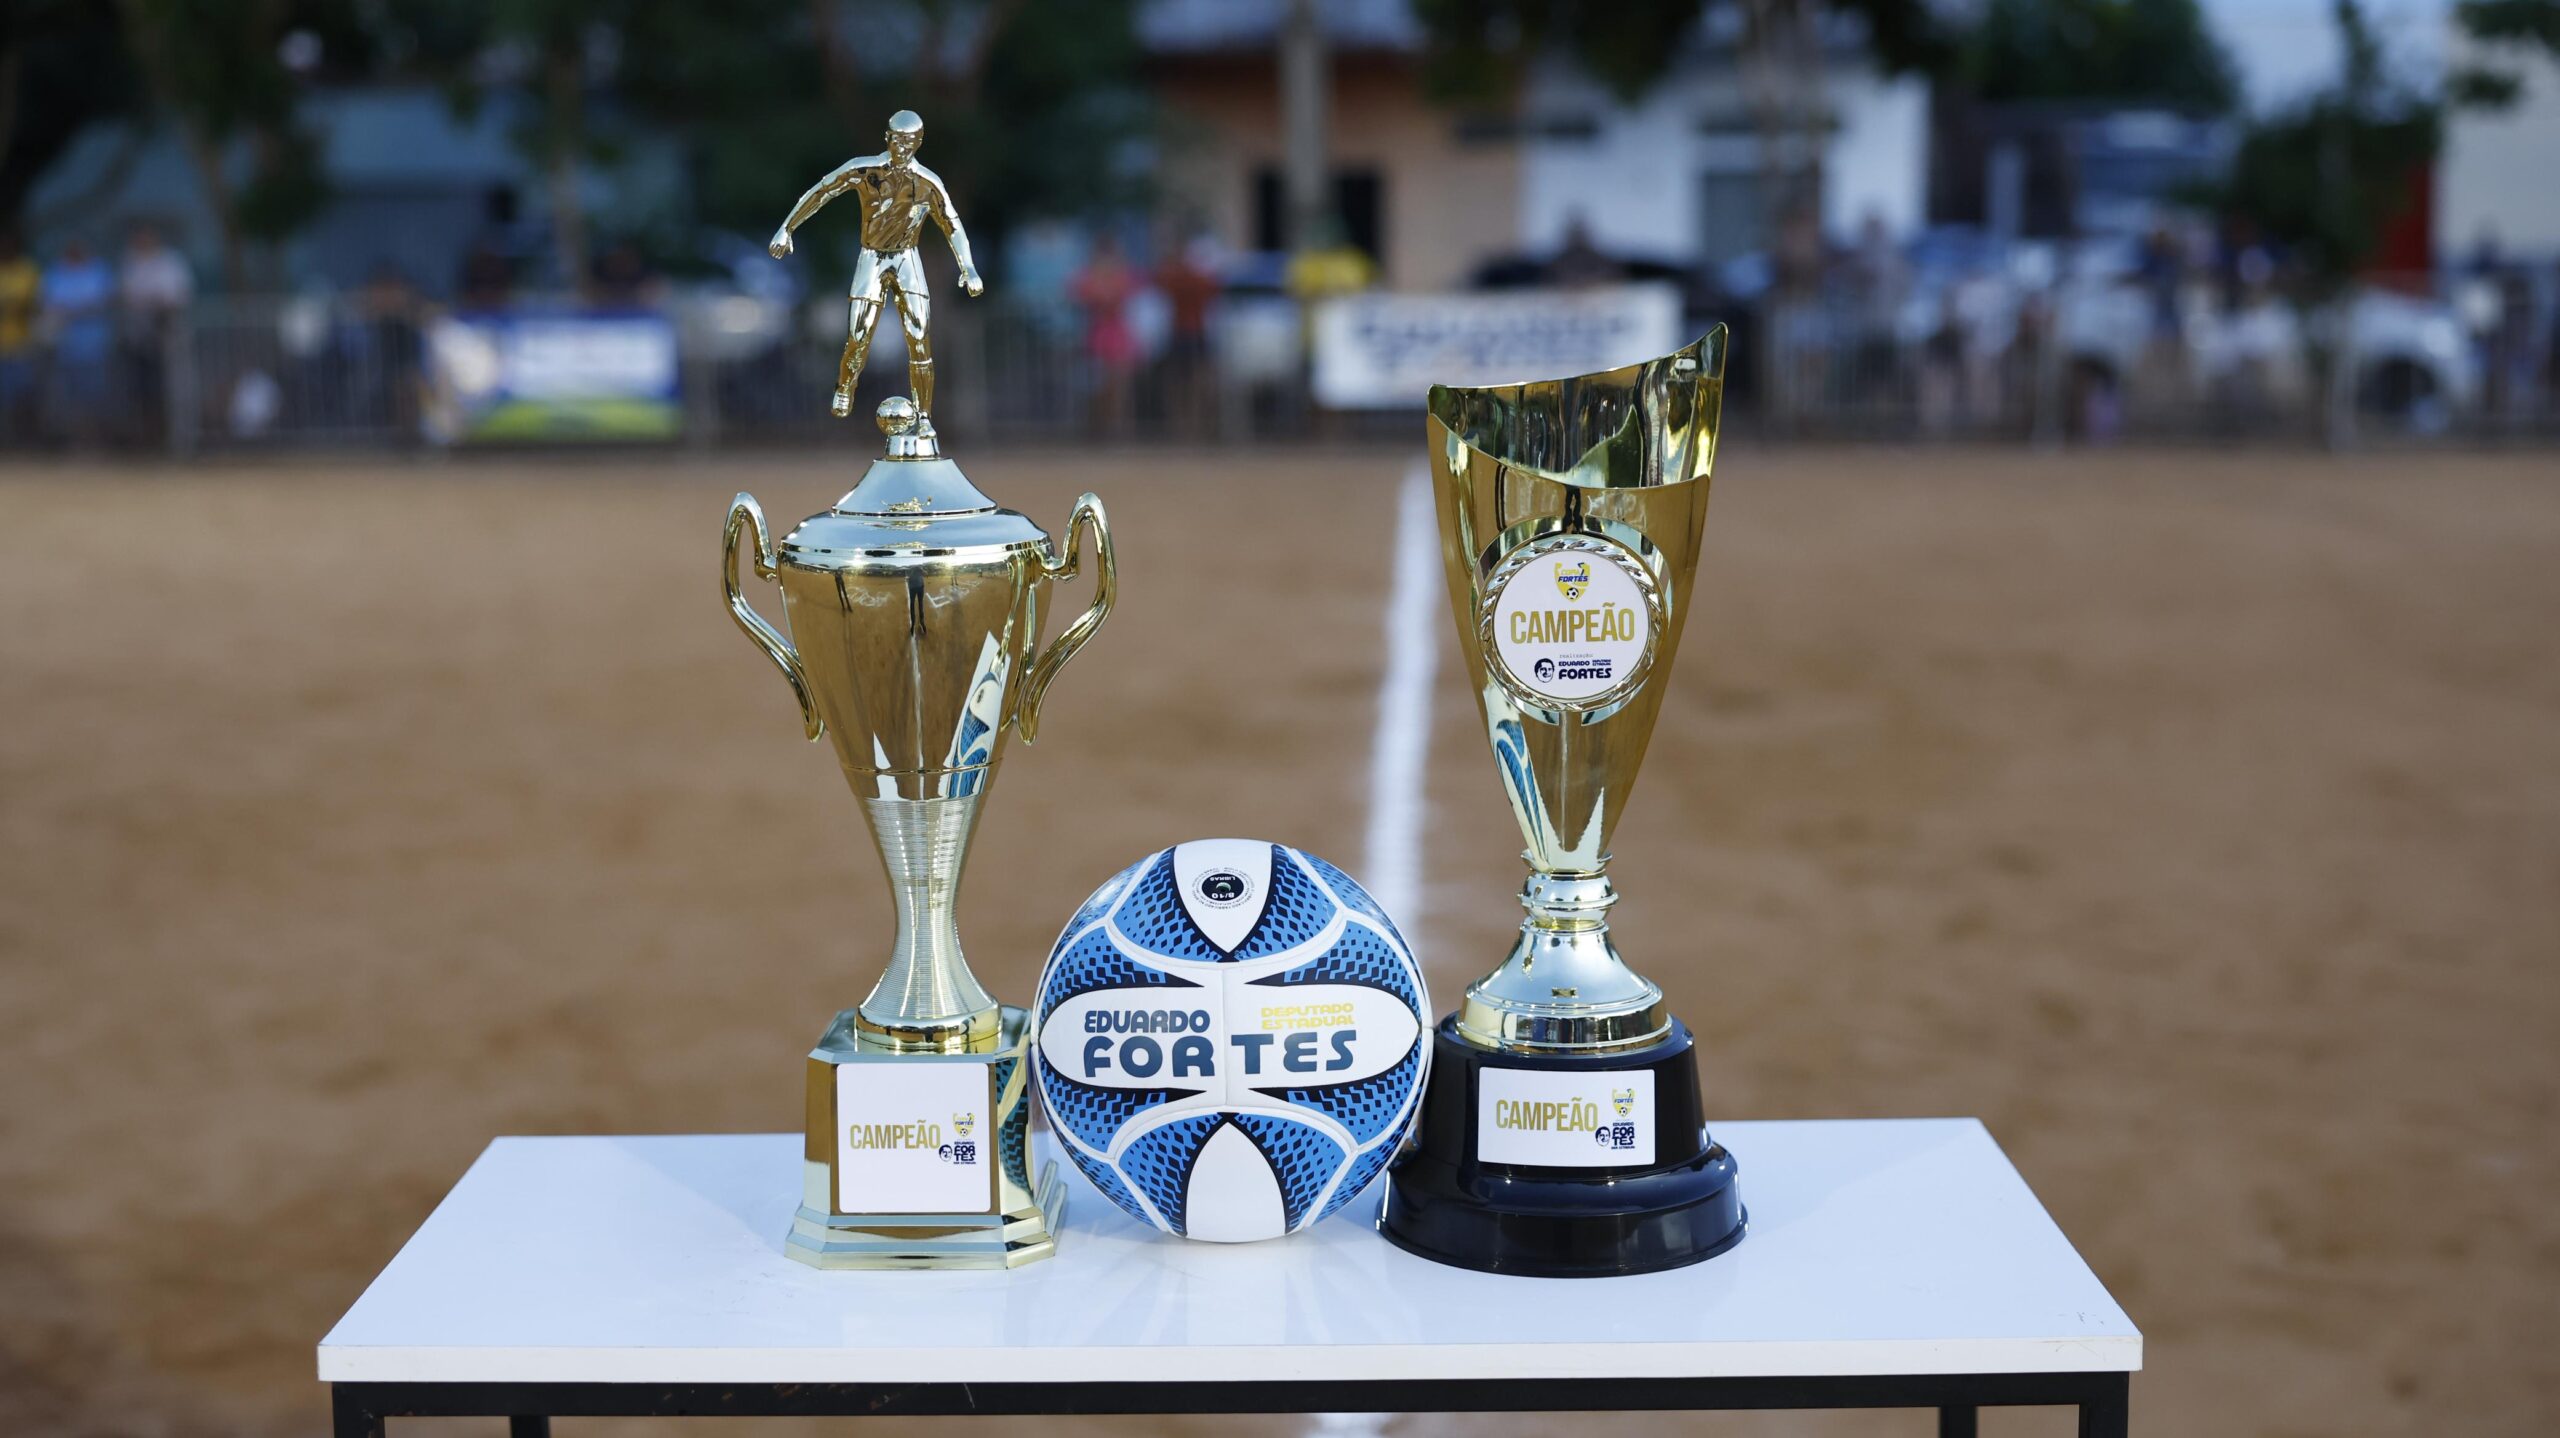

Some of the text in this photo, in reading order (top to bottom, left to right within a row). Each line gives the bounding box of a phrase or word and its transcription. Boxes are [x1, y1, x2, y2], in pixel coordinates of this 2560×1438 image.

[1510, 602, 1635, 644] CAMPEÃO
[1559, 668, 1612, 680] FORTES
[1261, 1003, 1354, 1018] DEPUTADO
[1084, 1010, 1210, 1033] EDUARDO
[1262, 1015, 1354, 1030] ESTADUAL
[1495, 1097, 1598, 1132] CAMPEÃO
[850, 1119, 940, 1149] CAMPEÃO
[1613, 1127, 1635, 1137] FOR
[1612, 1136, 1635, 1146] TES
[954, 1145, 975, 1154] FOR
[954, 1153, 976, 1161] TES
